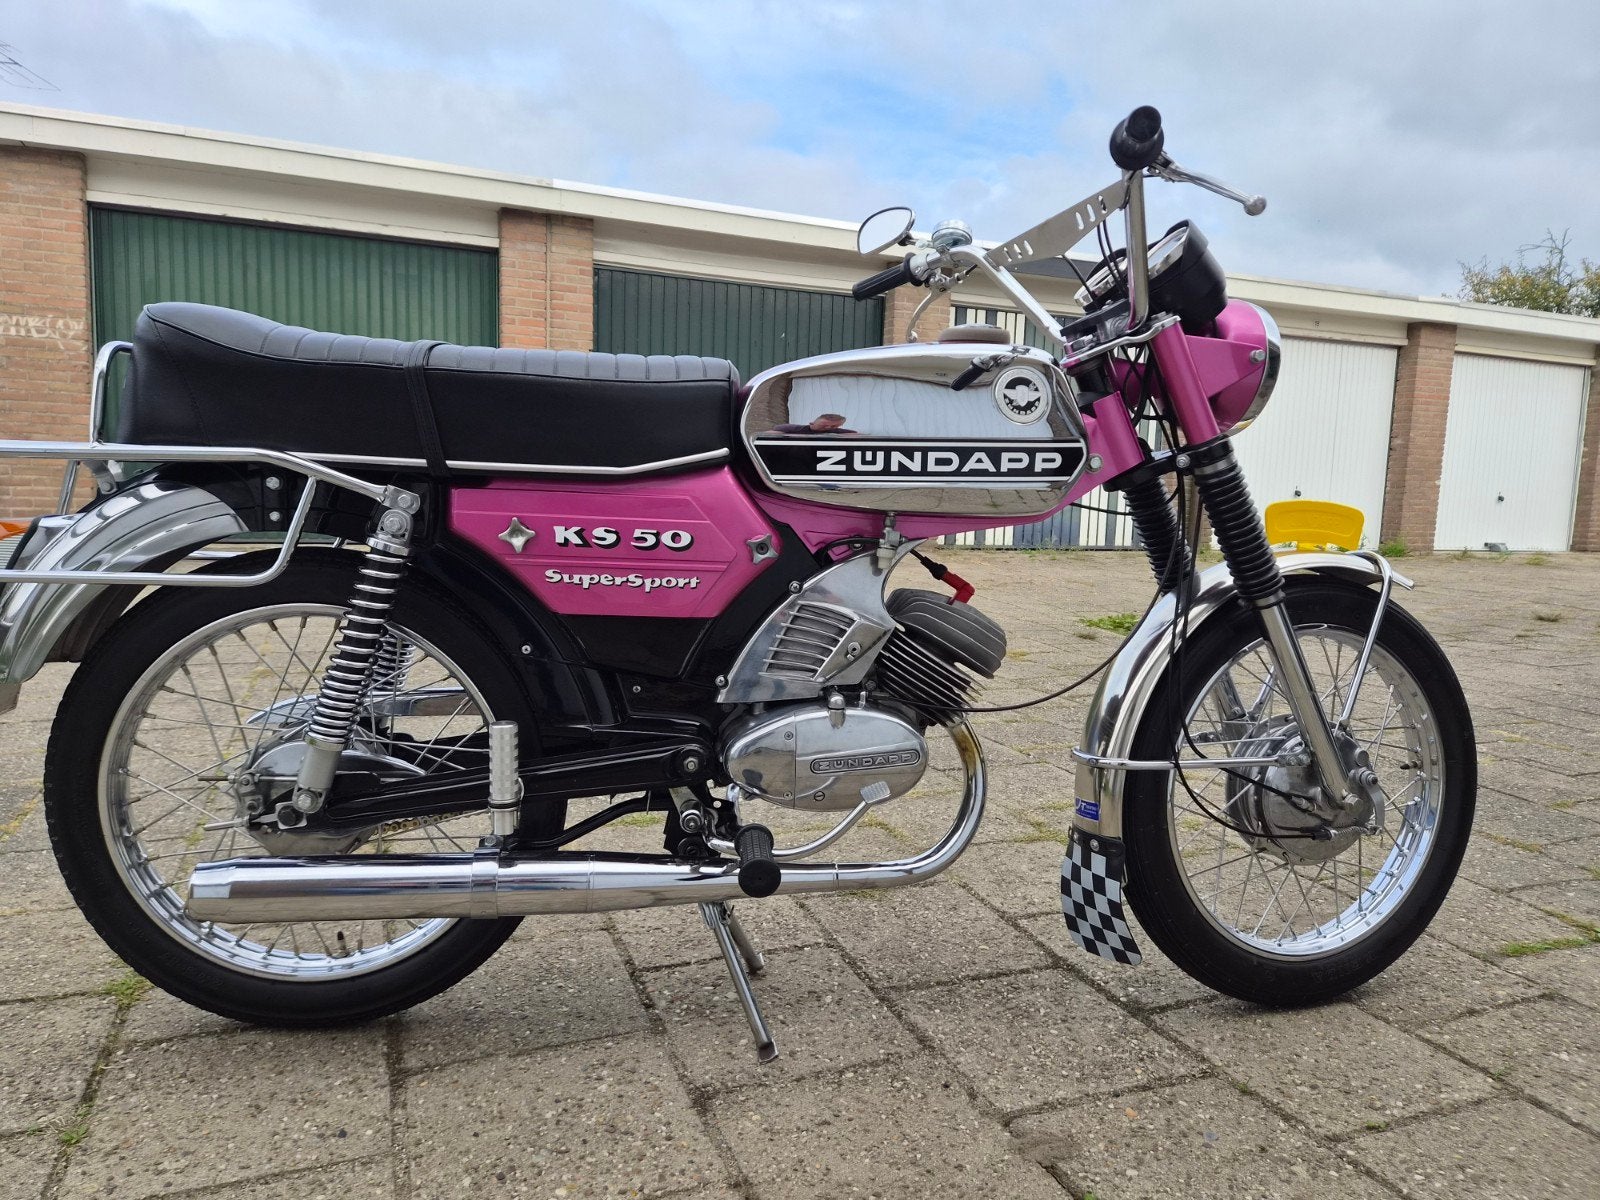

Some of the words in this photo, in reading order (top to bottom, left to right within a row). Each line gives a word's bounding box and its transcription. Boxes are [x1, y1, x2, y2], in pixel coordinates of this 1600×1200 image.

[816, 450, 1063, 473] ZÜNDAPP
[553, 525, 621, 549] KS
[630, 528, 694, 552] 50
[544, 568, 701, 593] SuperSport
